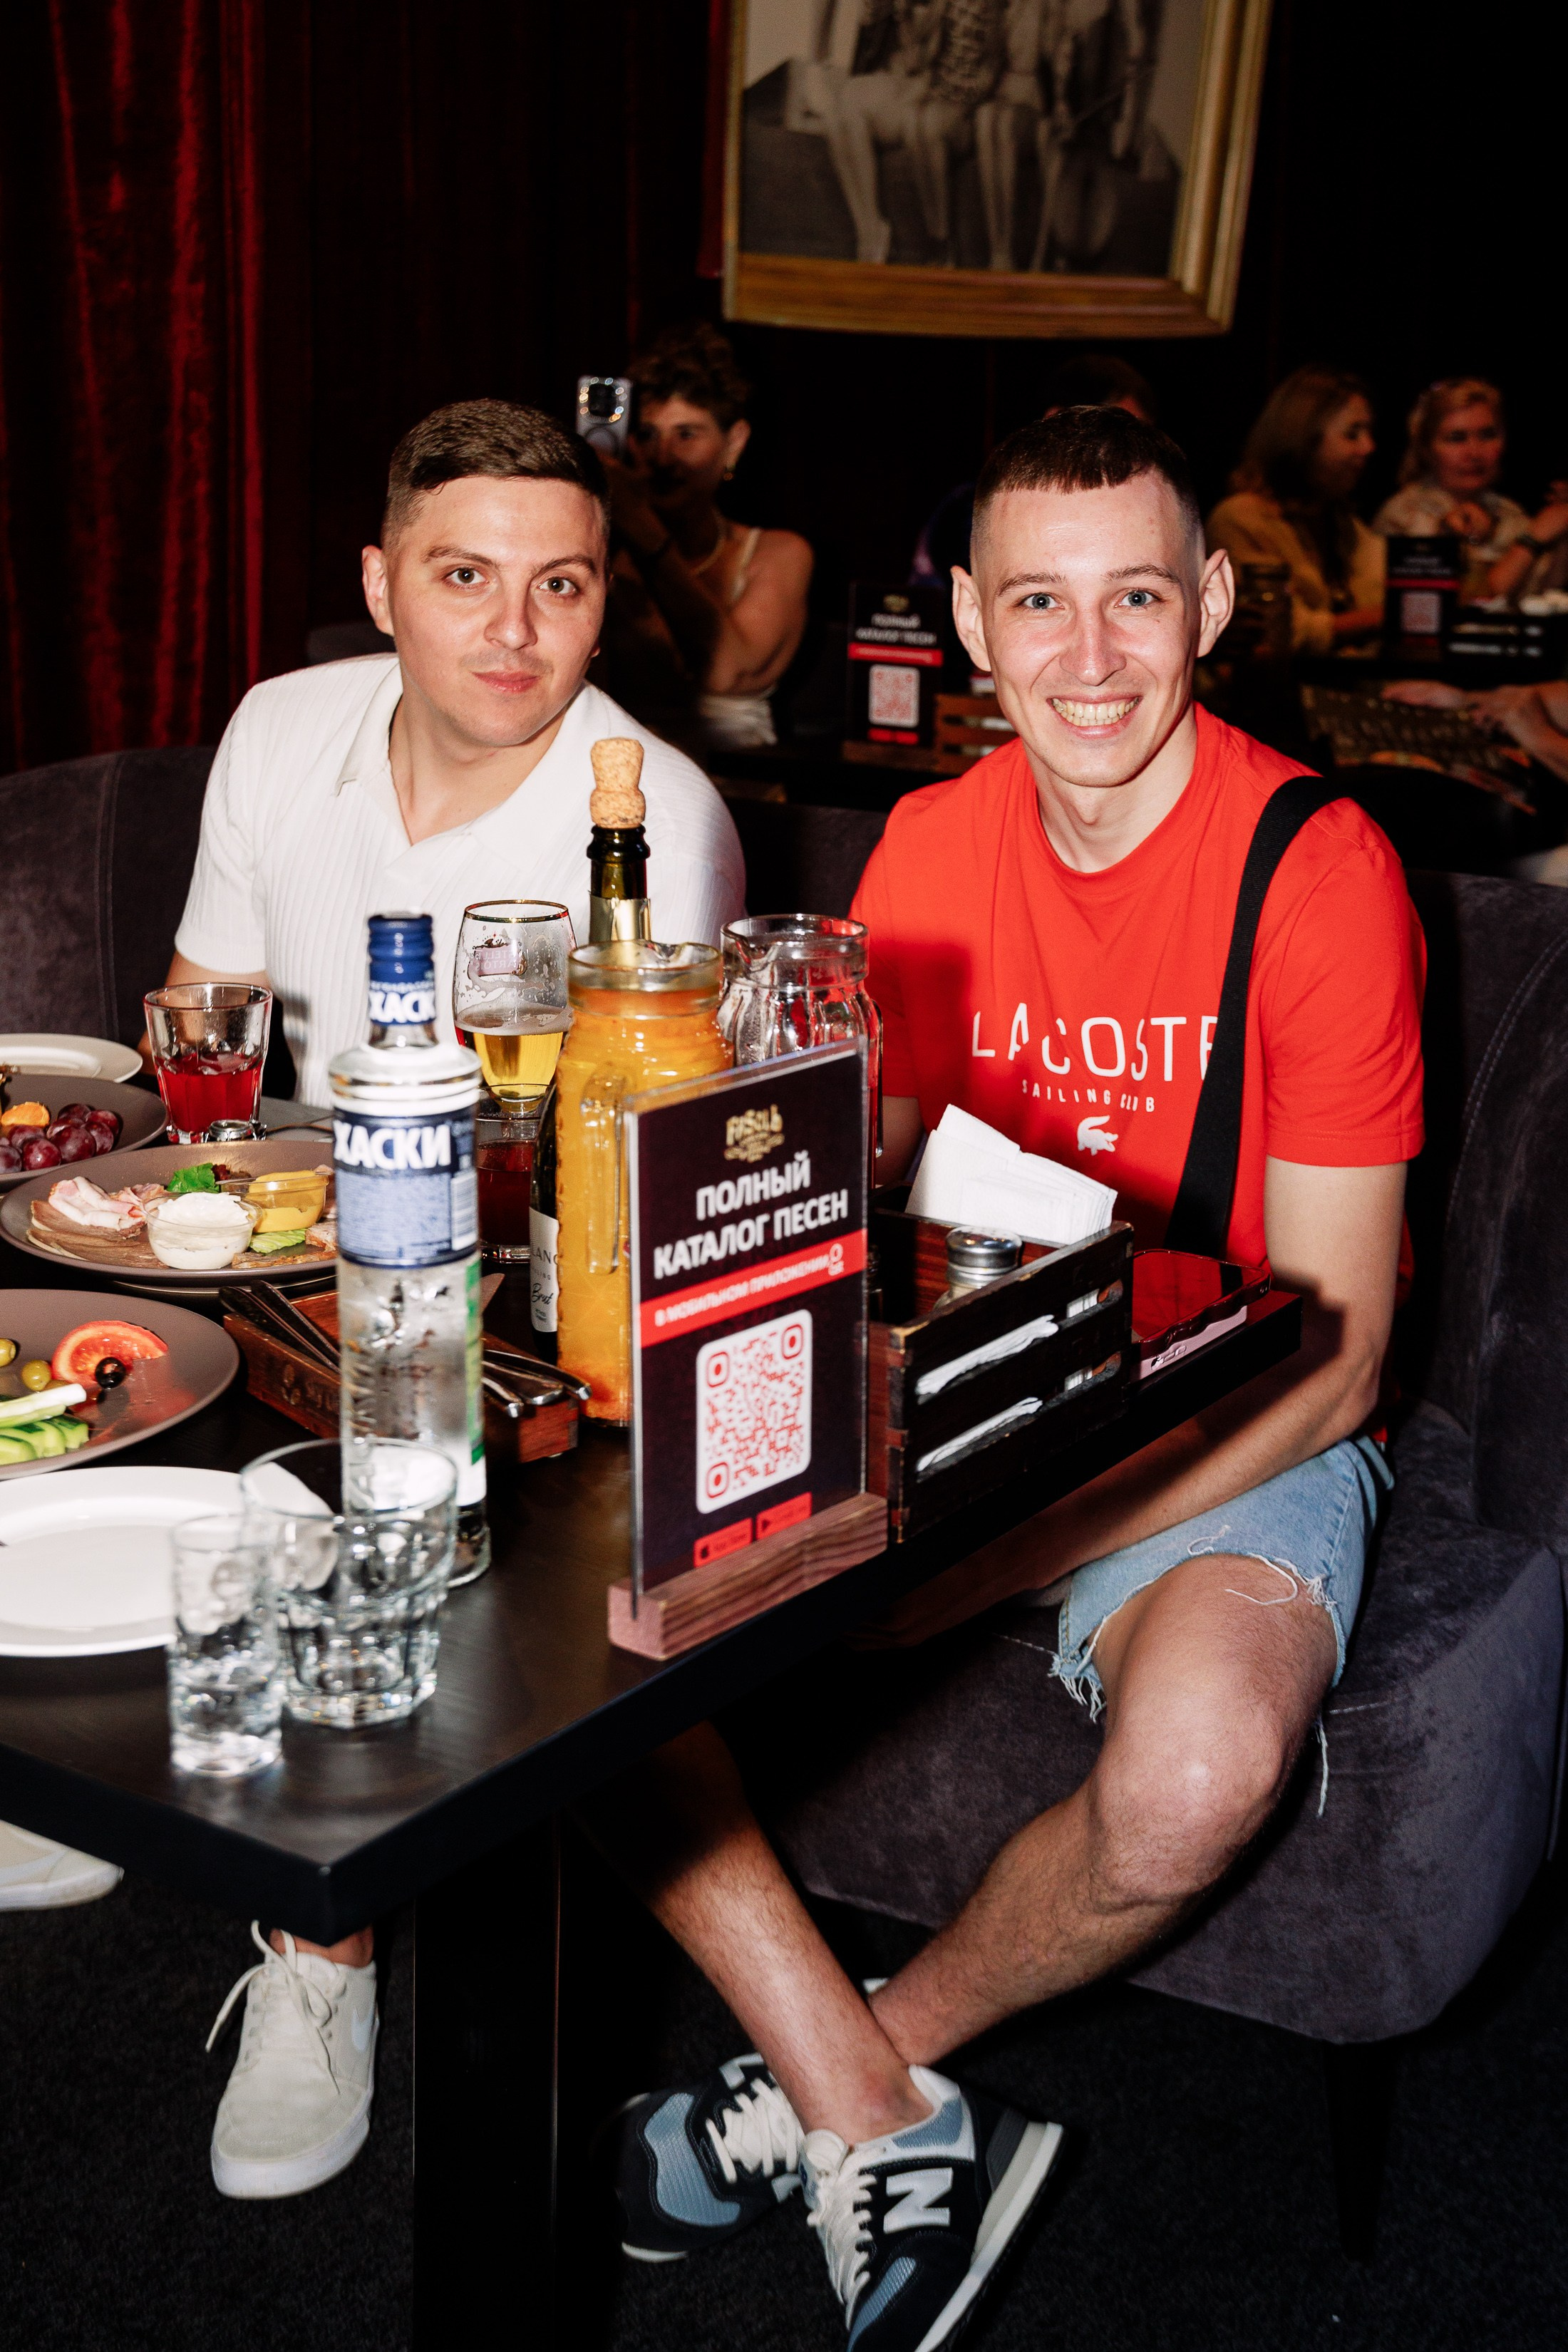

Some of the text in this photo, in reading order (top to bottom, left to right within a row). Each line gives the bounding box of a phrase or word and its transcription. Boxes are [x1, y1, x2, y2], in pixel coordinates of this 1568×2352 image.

[1022, 1079, 1110, 1105] SAILING
[333, 1119, 451, 1170] ХАСКИ
[696, 1150, 811, 1220] ПОЛНЫЙ
[654, 1189, 848, 1279] КАТАЛОГ ПЕСЕН
